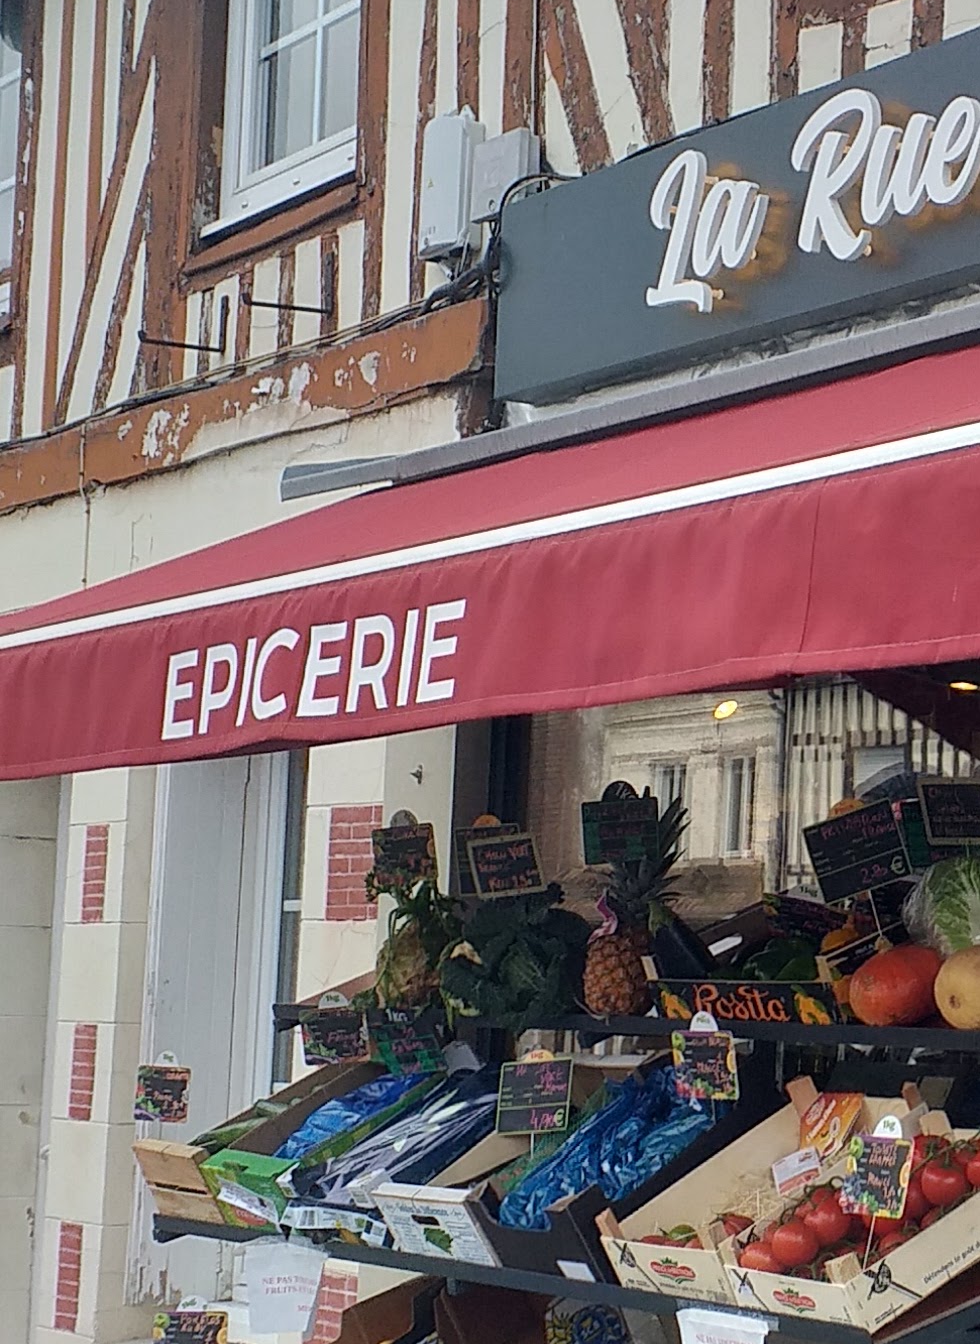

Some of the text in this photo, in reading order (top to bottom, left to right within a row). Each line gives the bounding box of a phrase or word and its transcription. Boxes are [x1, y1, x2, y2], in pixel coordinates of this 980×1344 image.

[646, 149, 769, 313] La
[161, 599, 466, 740] EPICERIE
[693, 983, 791, 1023] Rosita
[277, 1276, 293, 1284] PAS
